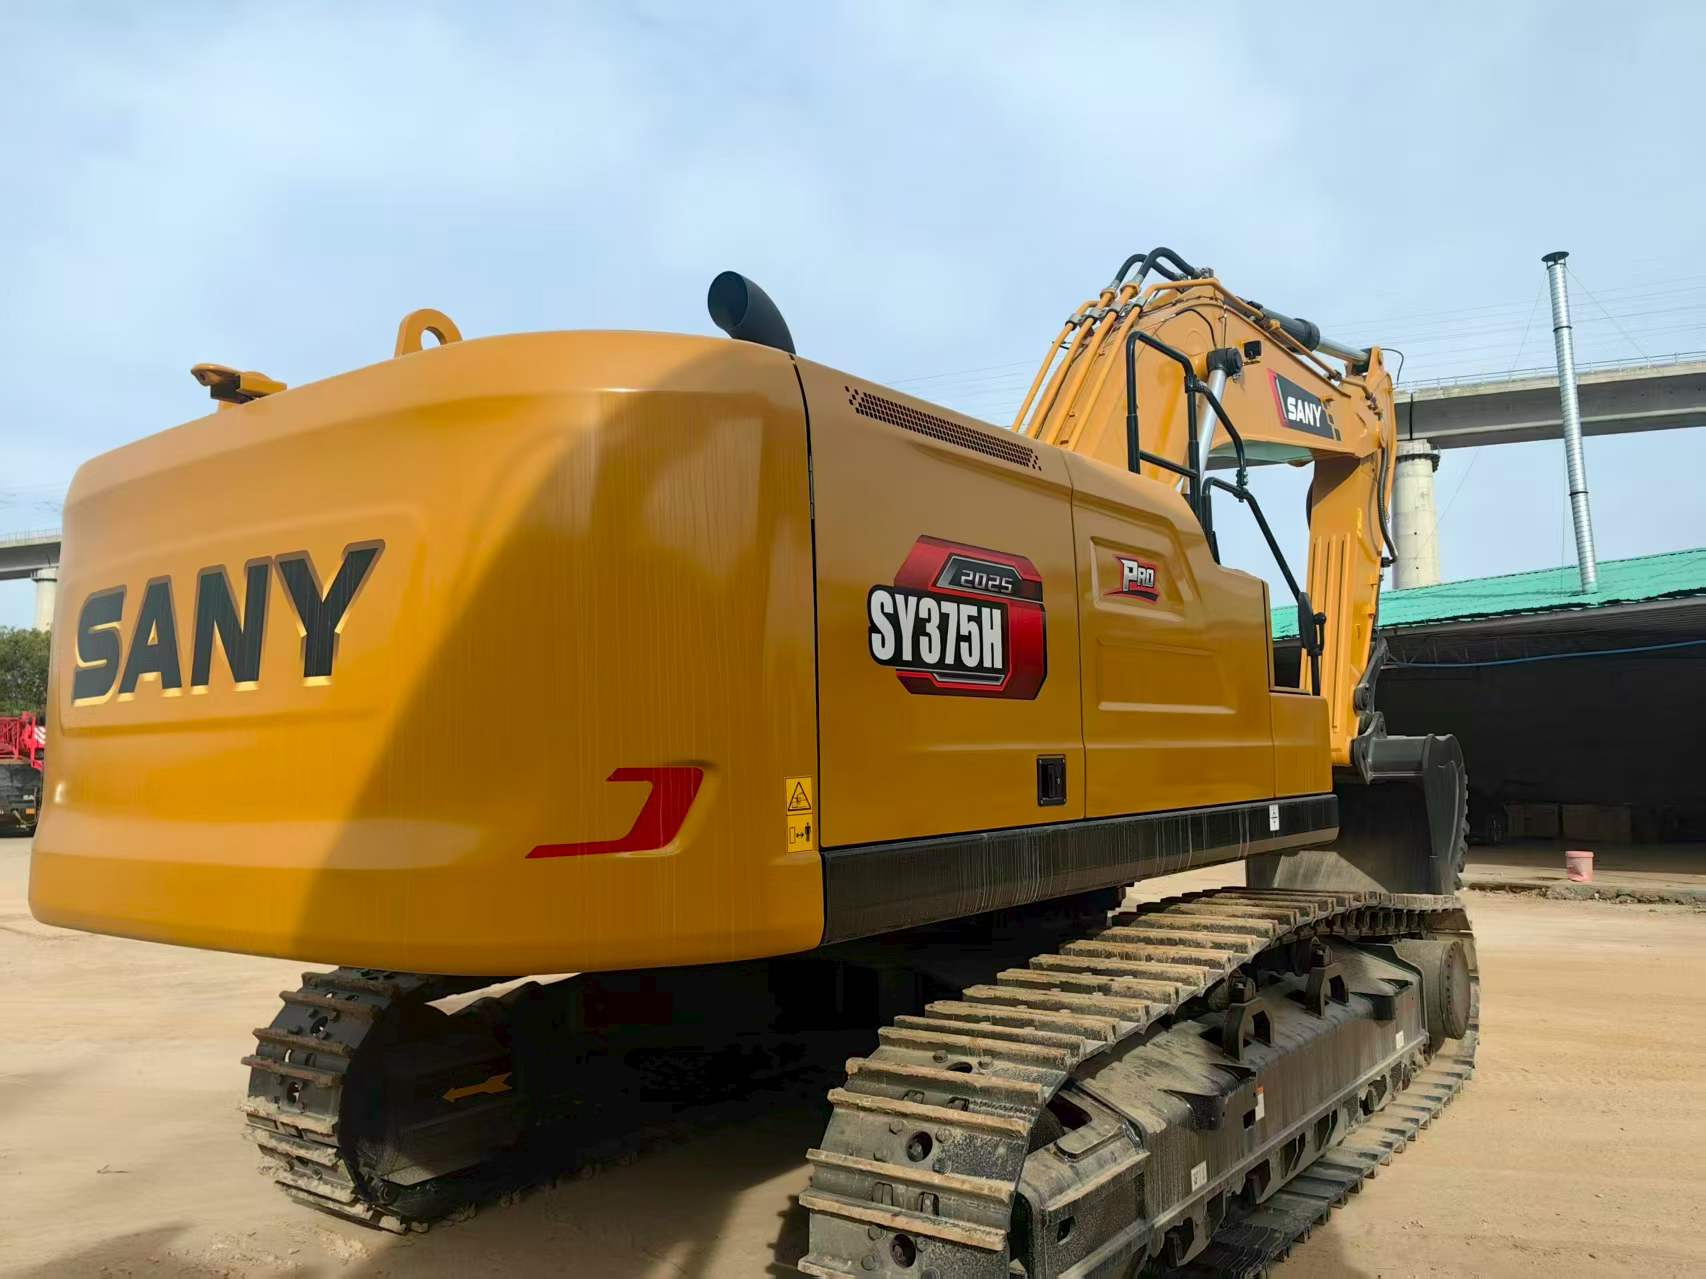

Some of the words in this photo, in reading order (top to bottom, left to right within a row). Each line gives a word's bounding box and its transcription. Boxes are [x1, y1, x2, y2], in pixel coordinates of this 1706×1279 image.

[1287, 397, 1322, 427] SANY
[960, 570, 1013, 593] 2025
[71, 539, 384, 706] SANY
[870, 590, 1003, 669] SY375H
